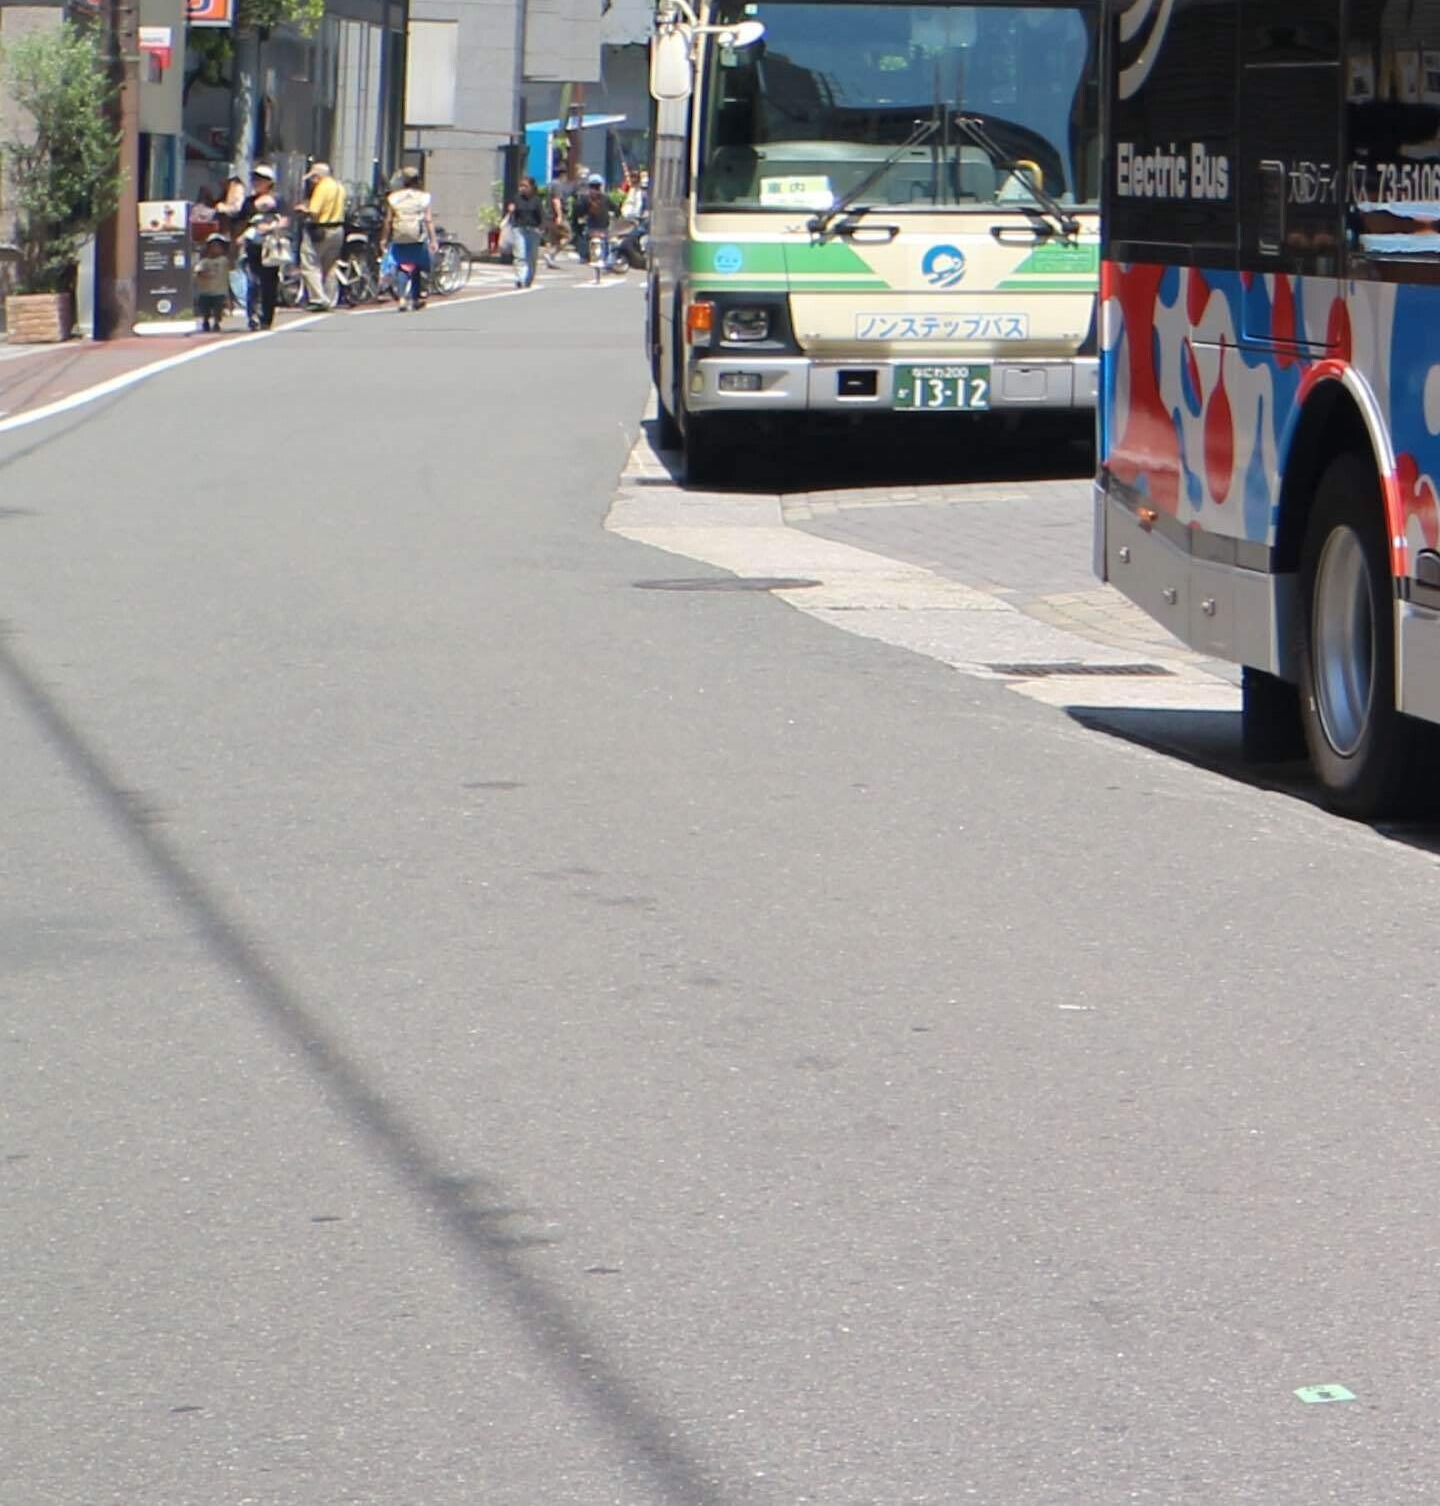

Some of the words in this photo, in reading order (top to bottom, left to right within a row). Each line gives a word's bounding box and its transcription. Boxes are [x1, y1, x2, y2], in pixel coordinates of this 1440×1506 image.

[1117, 144, 1186, 199] Electric
[1190, 144, 1229, 200] Bus
[860, 317, 1024, 339] ノンステップバス
[914, 379, 988, 407] 13-12
